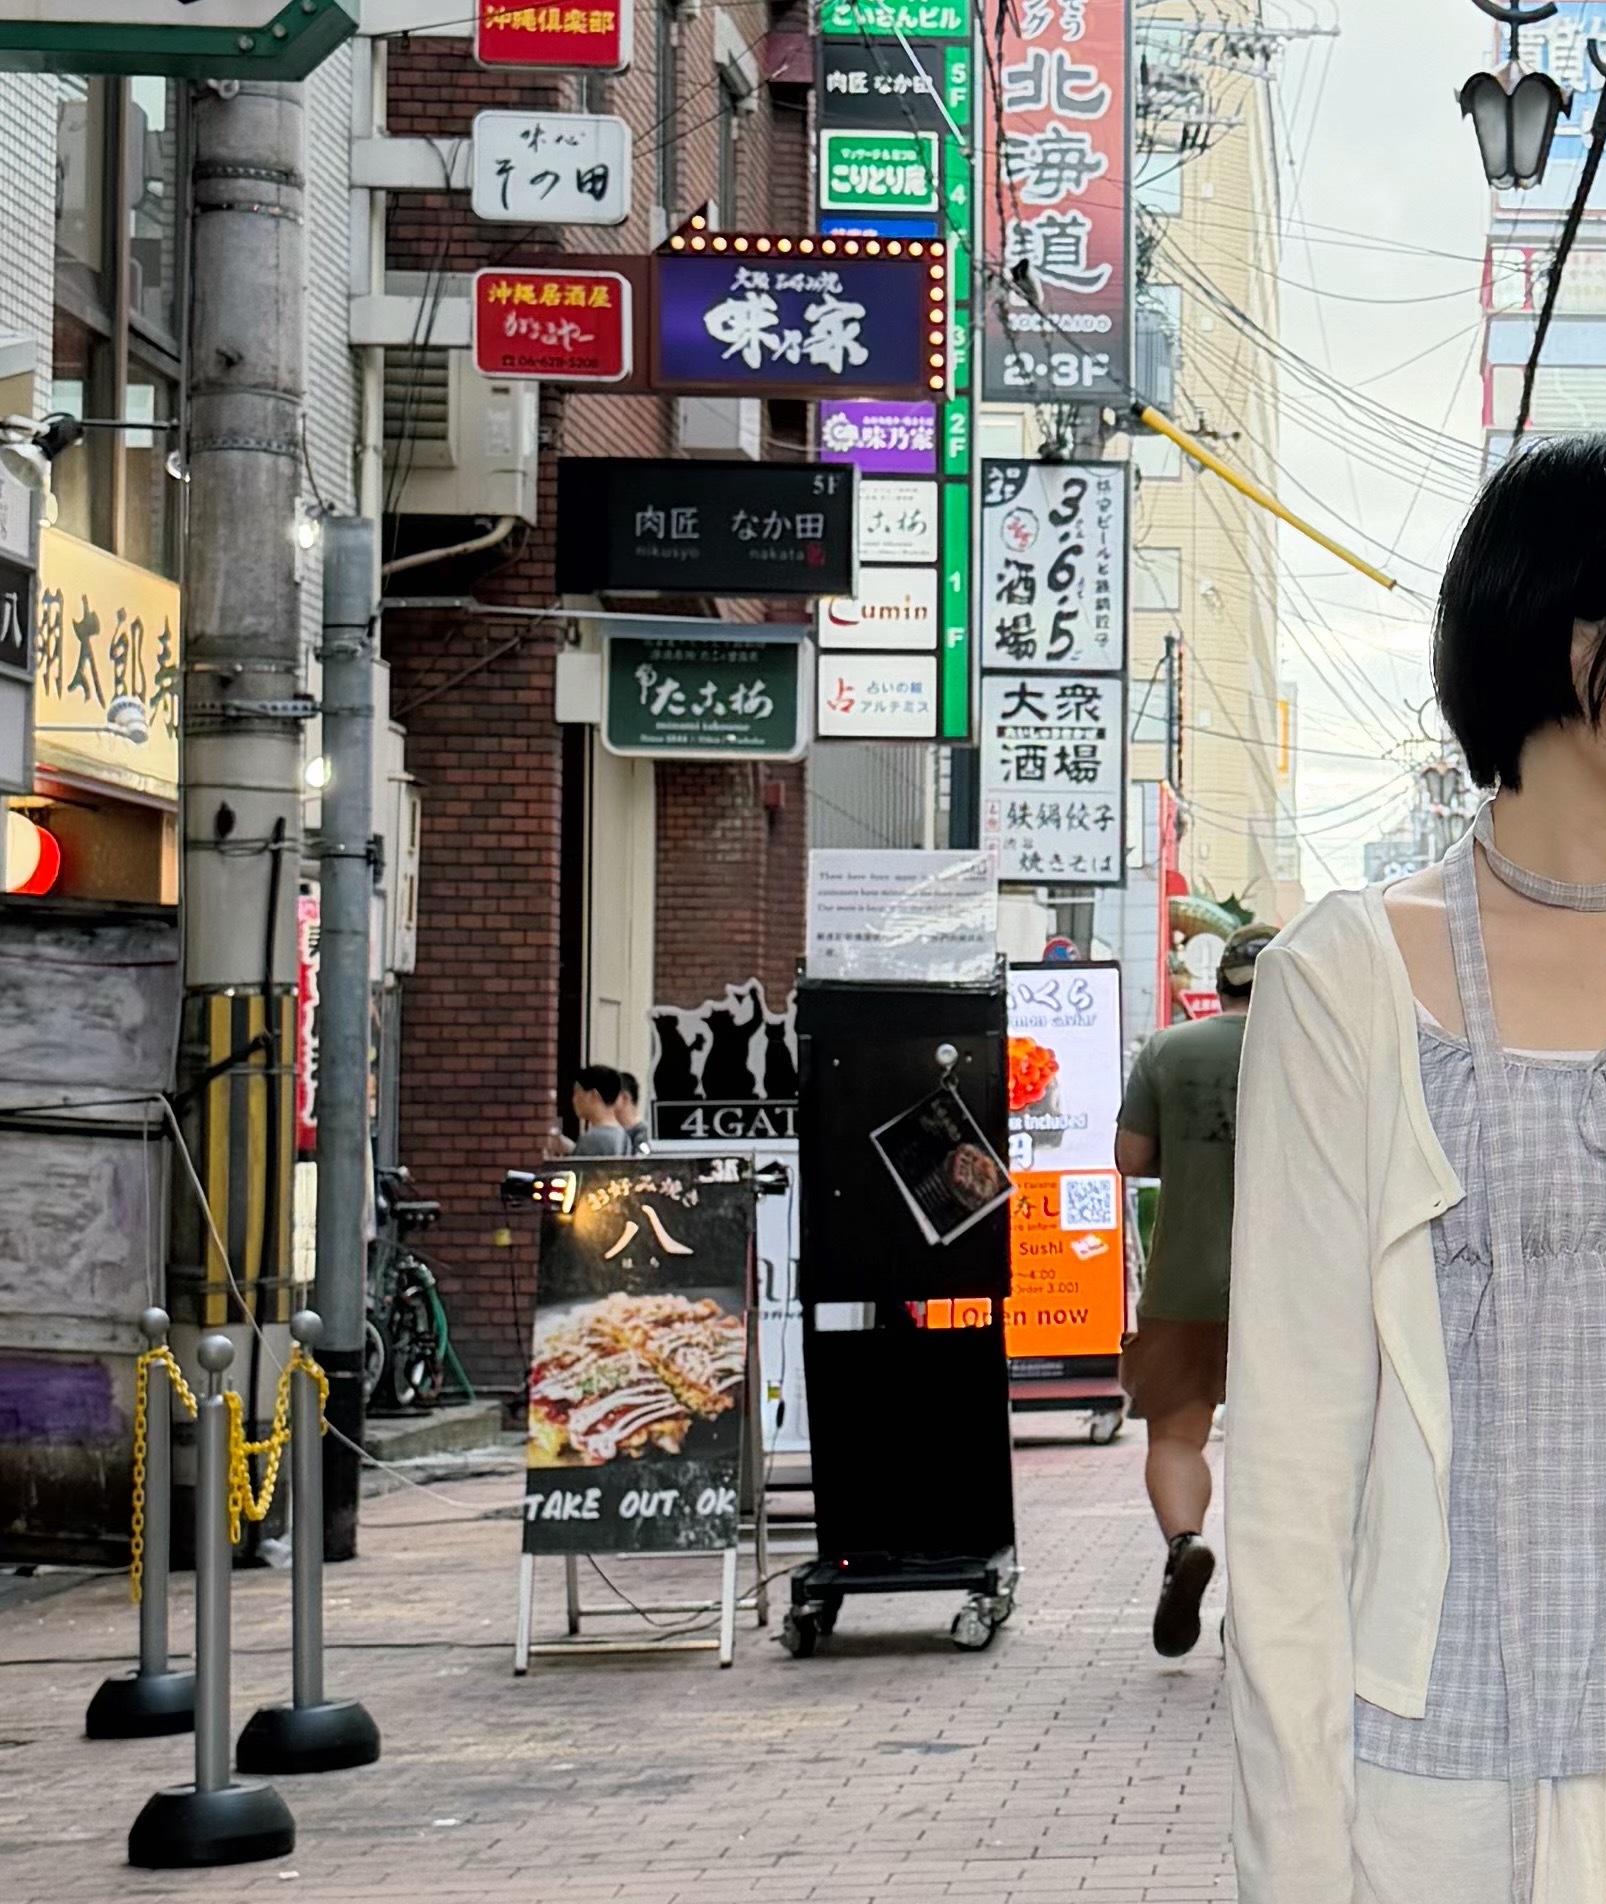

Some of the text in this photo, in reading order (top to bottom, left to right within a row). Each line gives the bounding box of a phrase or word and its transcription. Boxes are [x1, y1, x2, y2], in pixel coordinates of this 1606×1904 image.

[1003, 47, 1112, 293] 北海道
[488, 280, 613, 308] 沖縄居酒屋
[703, 291, 869, 375] 味乃家
[949, 412, 966, 457] 2F
[812, 474, 839, 495] 5F
[635, 505, 825, 541] 肉匠 なか田
[995, 557, 1037, 661] 酒場
[1000, 682, 1103, 722] 大衆
[1000, 743, 1103, 784] 酒場
[1024, 1113, 1088, 1131] included
[604, 1204, 695, 1265] 八
[1019, 1242, 1064, 1256] Sushi
[1038, 1308, 1089, 1326] now
[525, 1487, 737, 1521] TAKE OUT OK
